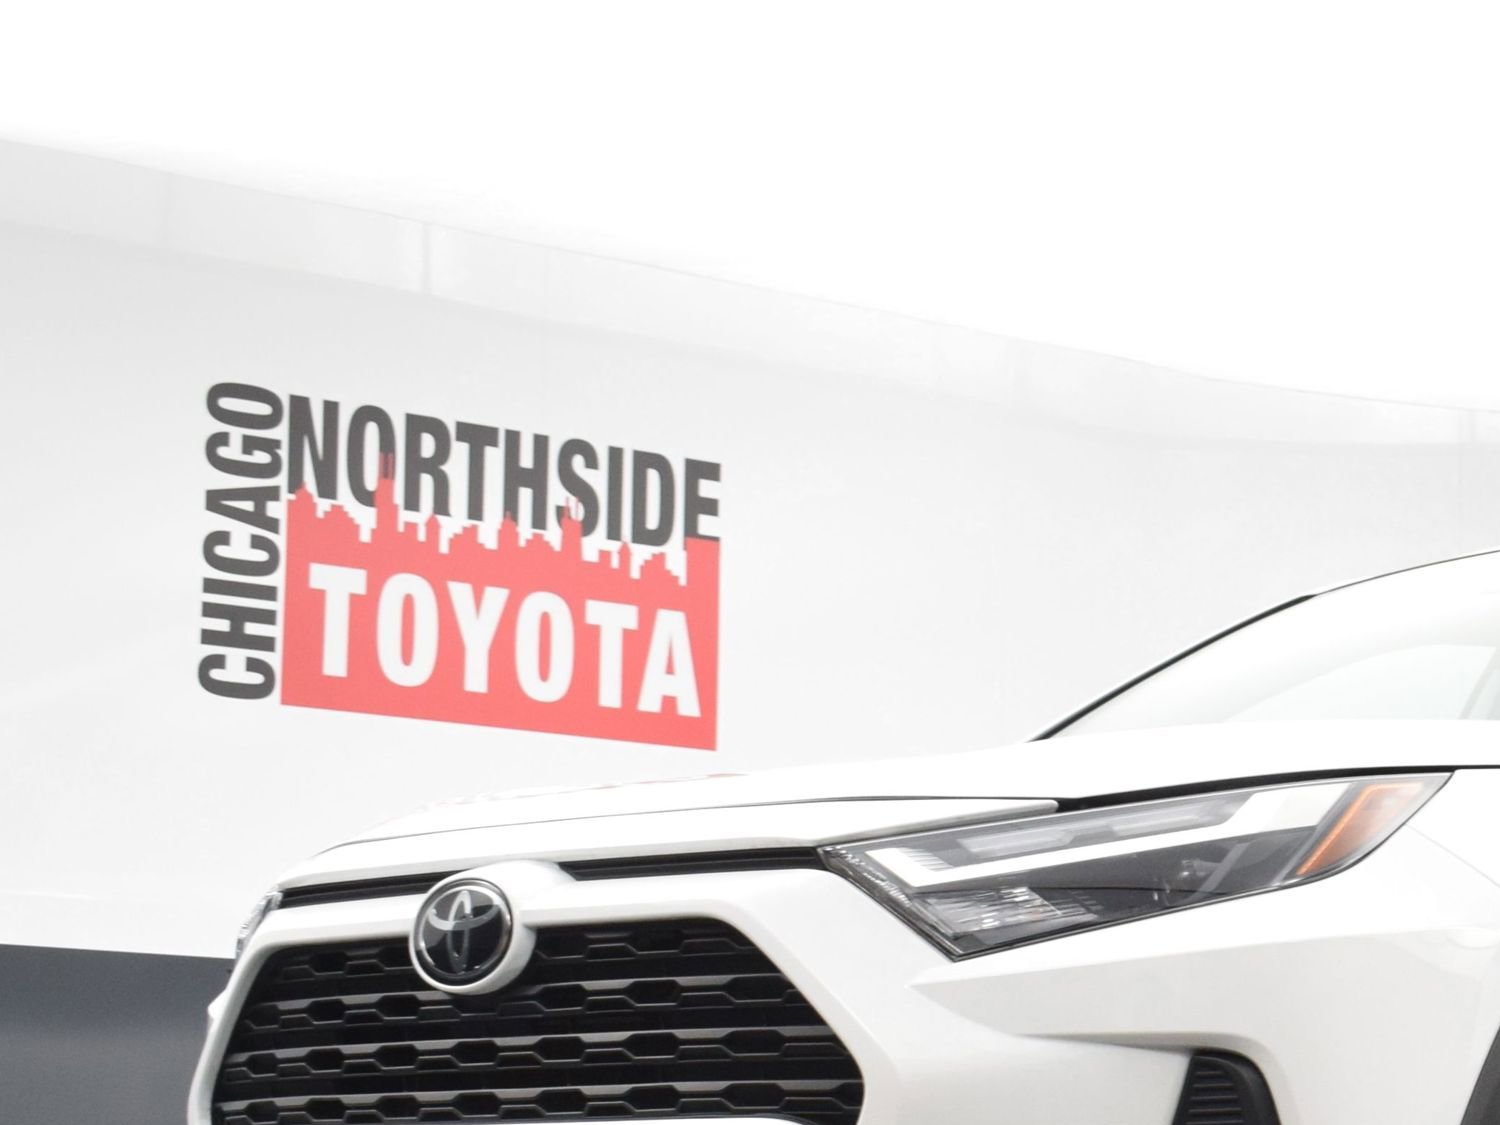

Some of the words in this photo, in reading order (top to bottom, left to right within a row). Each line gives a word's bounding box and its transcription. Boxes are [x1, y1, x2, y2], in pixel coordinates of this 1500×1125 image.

[197, 381, 284, 700] CHICAGO
[287, 394, 722, 550] NORTHSIDE
[308, 561, 701, 718] TOYOTA
